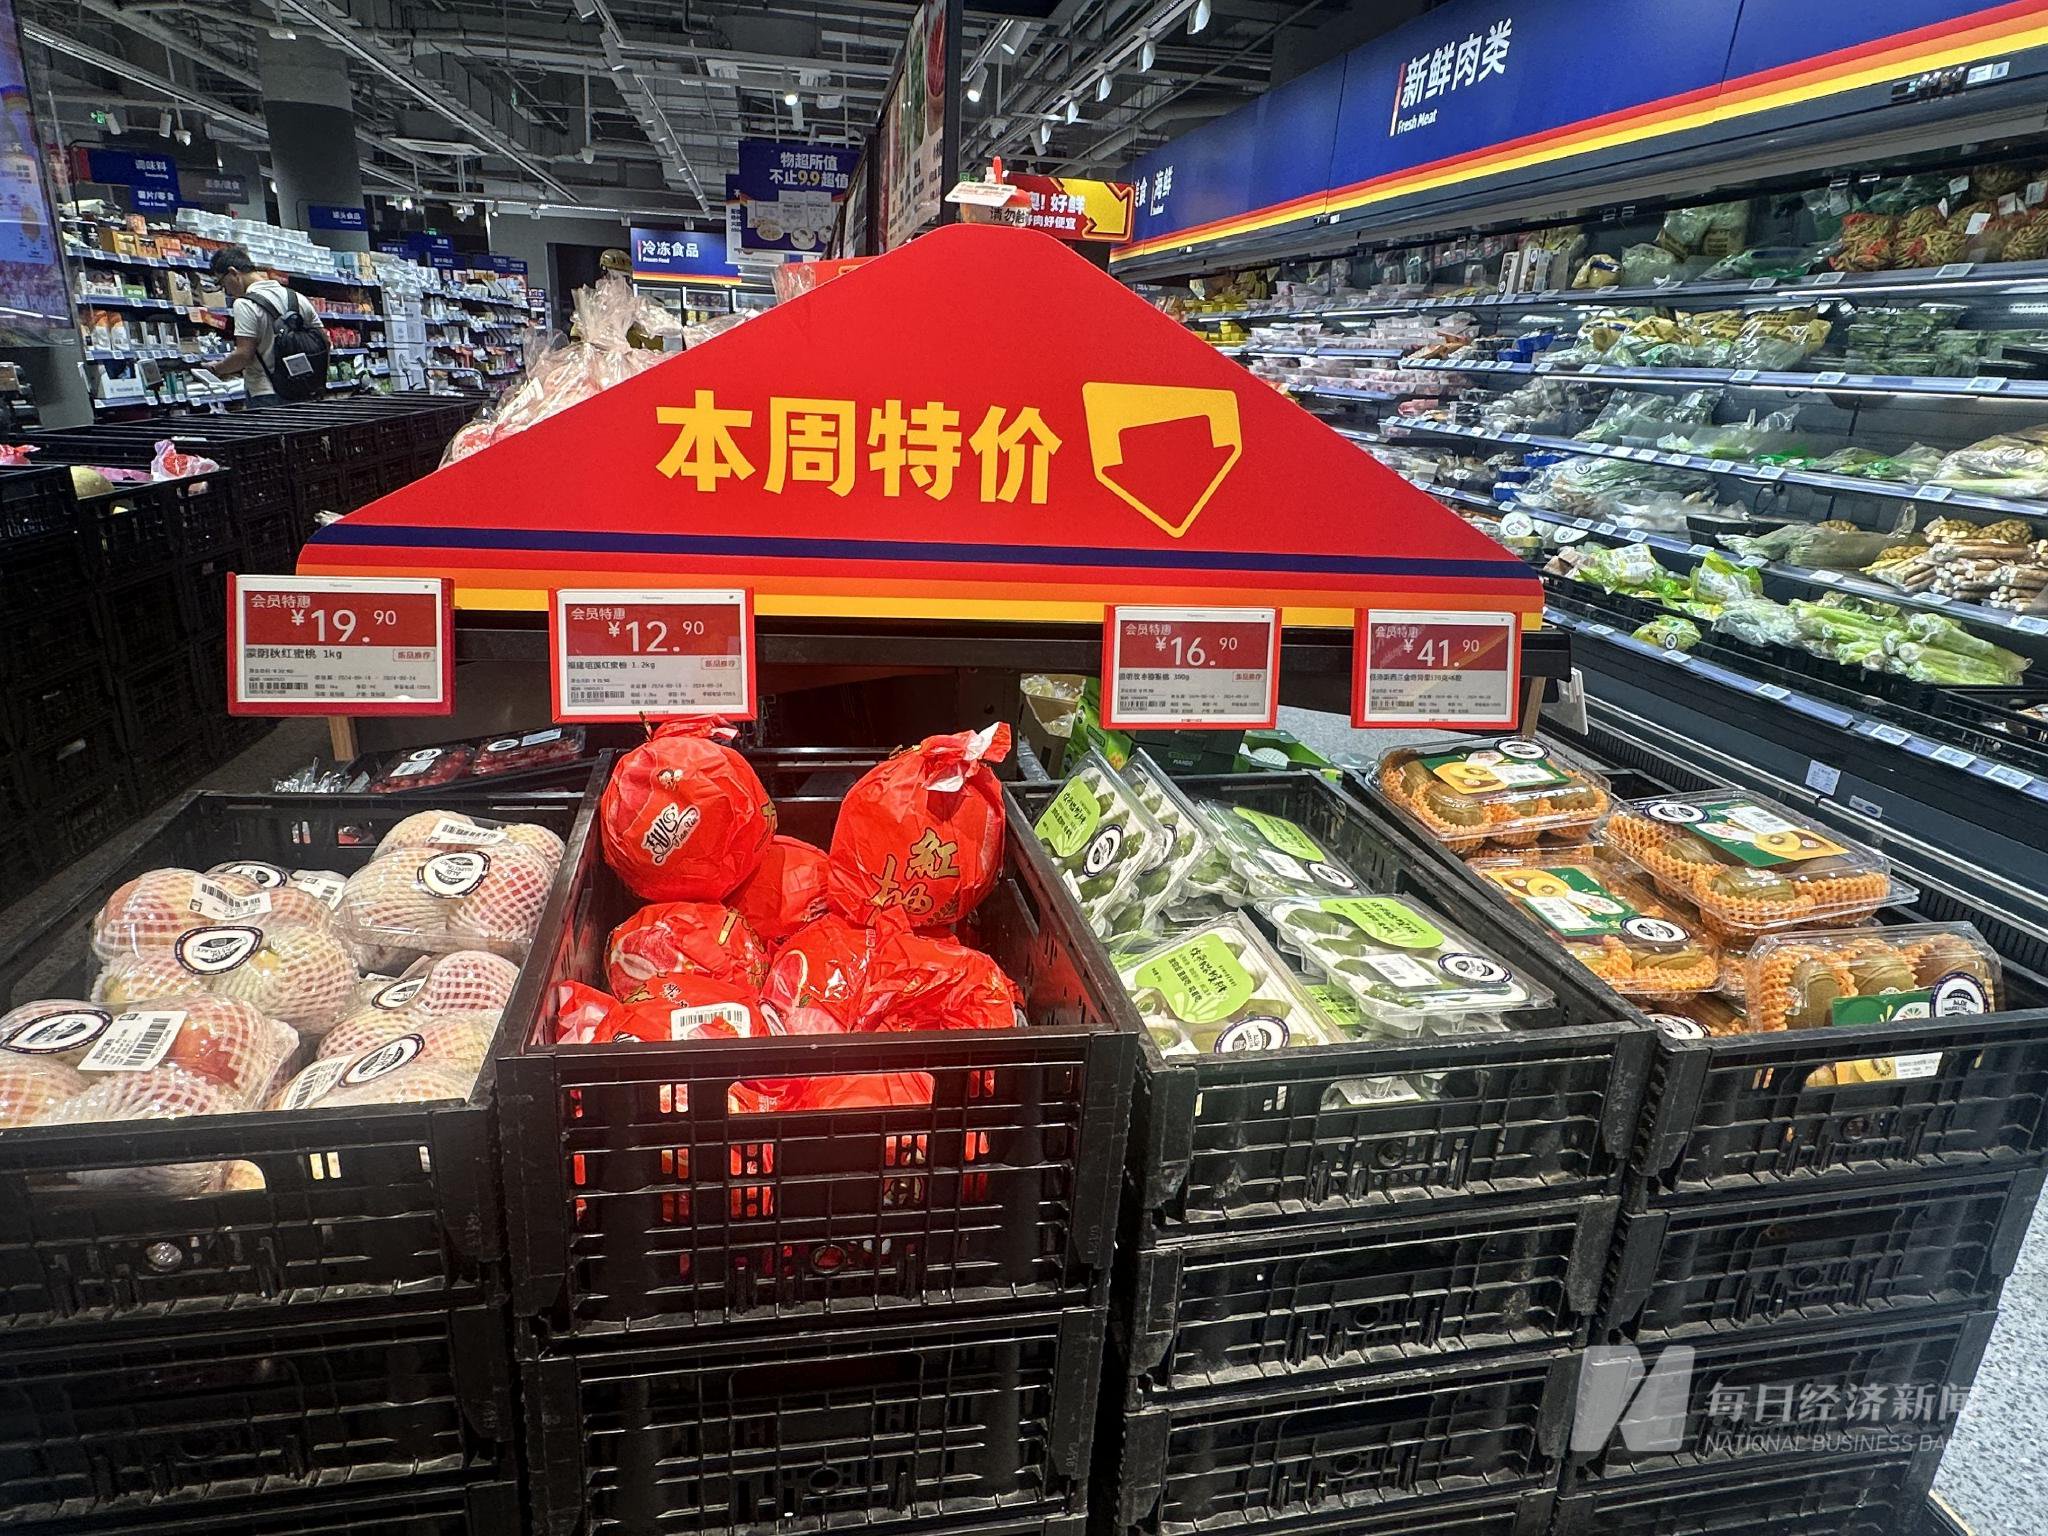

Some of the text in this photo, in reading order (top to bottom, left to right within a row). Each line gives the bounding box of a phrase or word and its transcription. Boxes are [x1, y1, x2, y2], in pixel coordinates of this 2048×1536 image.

[1401, 18, 1513, 109] 新鲜肉类
[1397, 109, 1438, 135] Fresh Meat
[781, 151, 838, 172] 物超所值
[769, 168, 849, 189] 不止9.9超值
[1050, 193, 1085, 216] 好鲜
[641, 239, 699, 258] 冷冻食品
[655, 388, 1063, 505] 本周特价
[250, 593, 311, 609] 会员特惠
[571, 607, 626, 621] 会员特惠
[1125, 623, 1172, 637] 会员特惠
[1374, 625, 1419, 639] 会员特惠
[323, 650, 342, 660] 1kg
